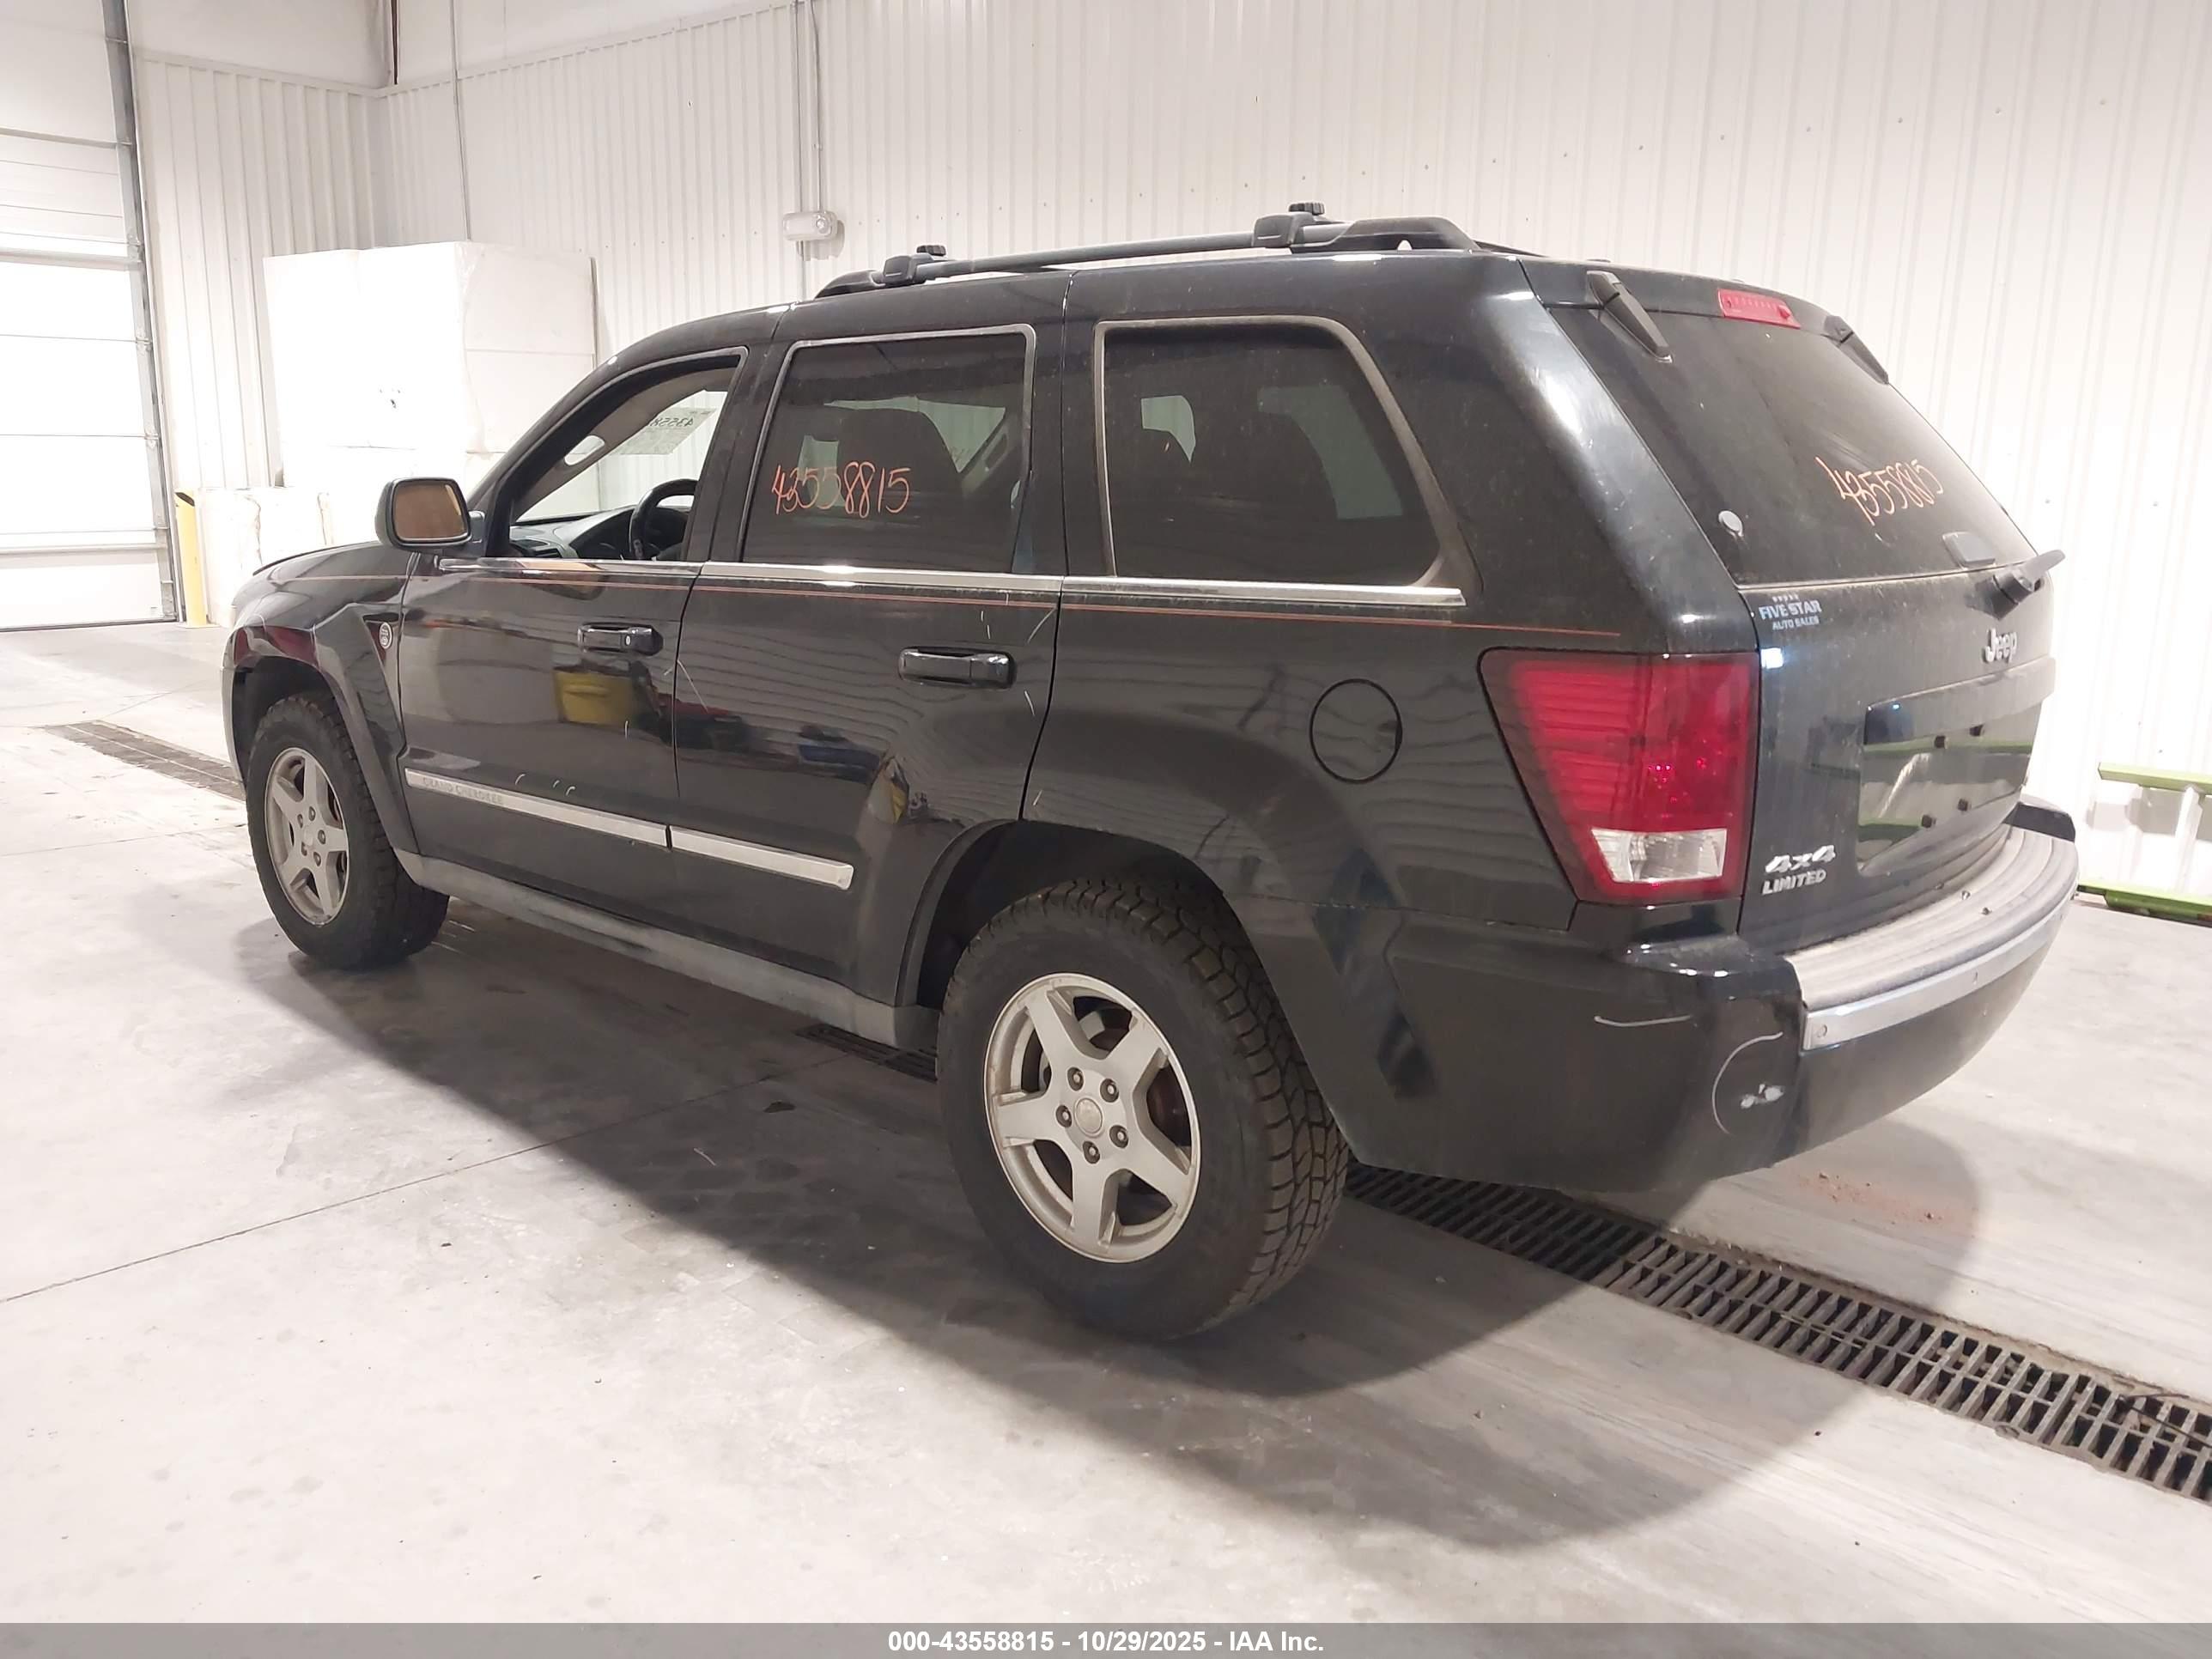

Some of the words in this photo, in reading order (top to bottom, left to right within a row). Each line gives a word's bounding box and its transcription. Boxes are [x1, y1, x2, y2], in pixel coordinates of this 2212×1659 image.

[771, 461, 911, 518] 43558815
[1759, 604, 1789, 620] FIVE
[1788, 599, 1822, 616] STAR
[1772, 618, 1795, 631] AUTO
[1984, 628, 2018, 662] Jeep
[1762, 869, 1826, 895] LIMITED
